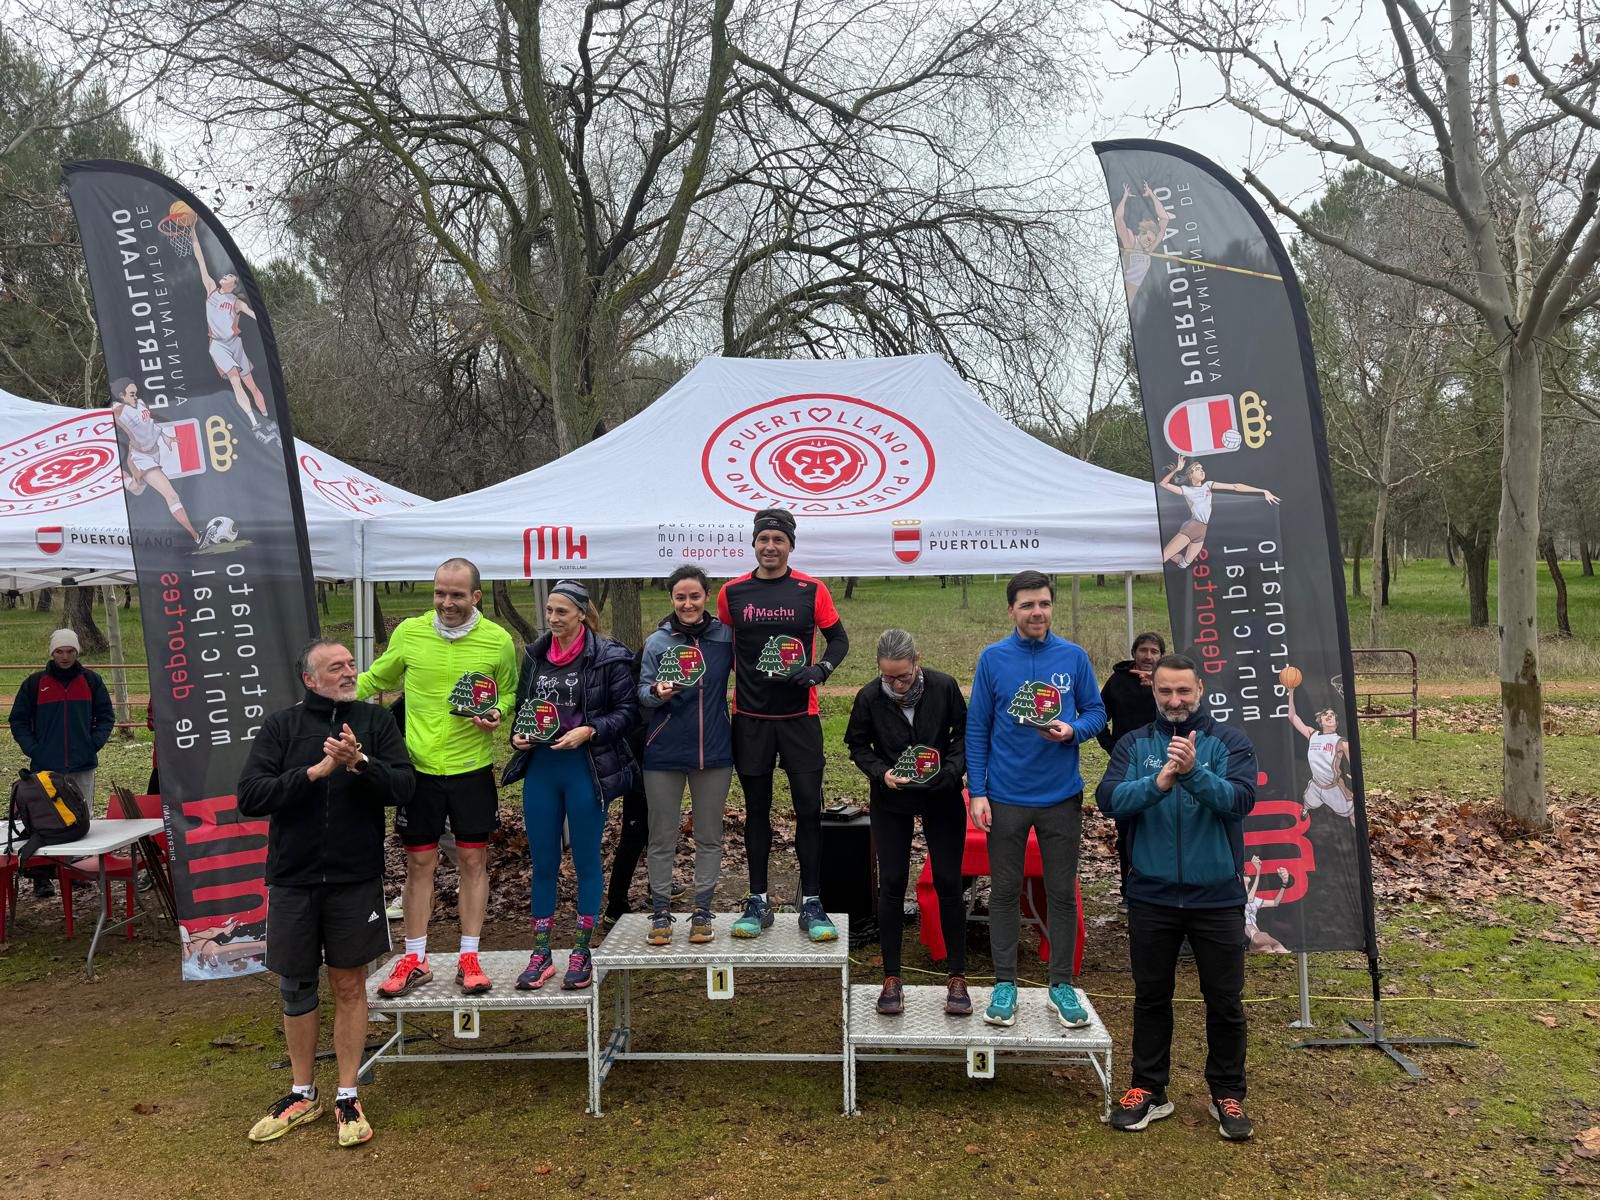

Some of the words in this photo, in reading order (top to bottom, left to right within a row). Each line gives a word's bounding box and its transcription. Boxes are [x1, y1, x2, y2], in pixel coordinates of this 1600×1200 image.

[658, 530, 744, 545] municipal
[929, 529, 1018, 537] AYUNTAMIENTO
[929, 538, 1040, 551] PUERTOLLANO
[658, 546, 673, 558] de
[682, 546, 744, 561] deportes
[756, 607, 795, 617] Machu
[716, 971, 724, 990] 1
[461, 1013, 472, 1031] 2
[975, 1052, 986, 1071] 3
